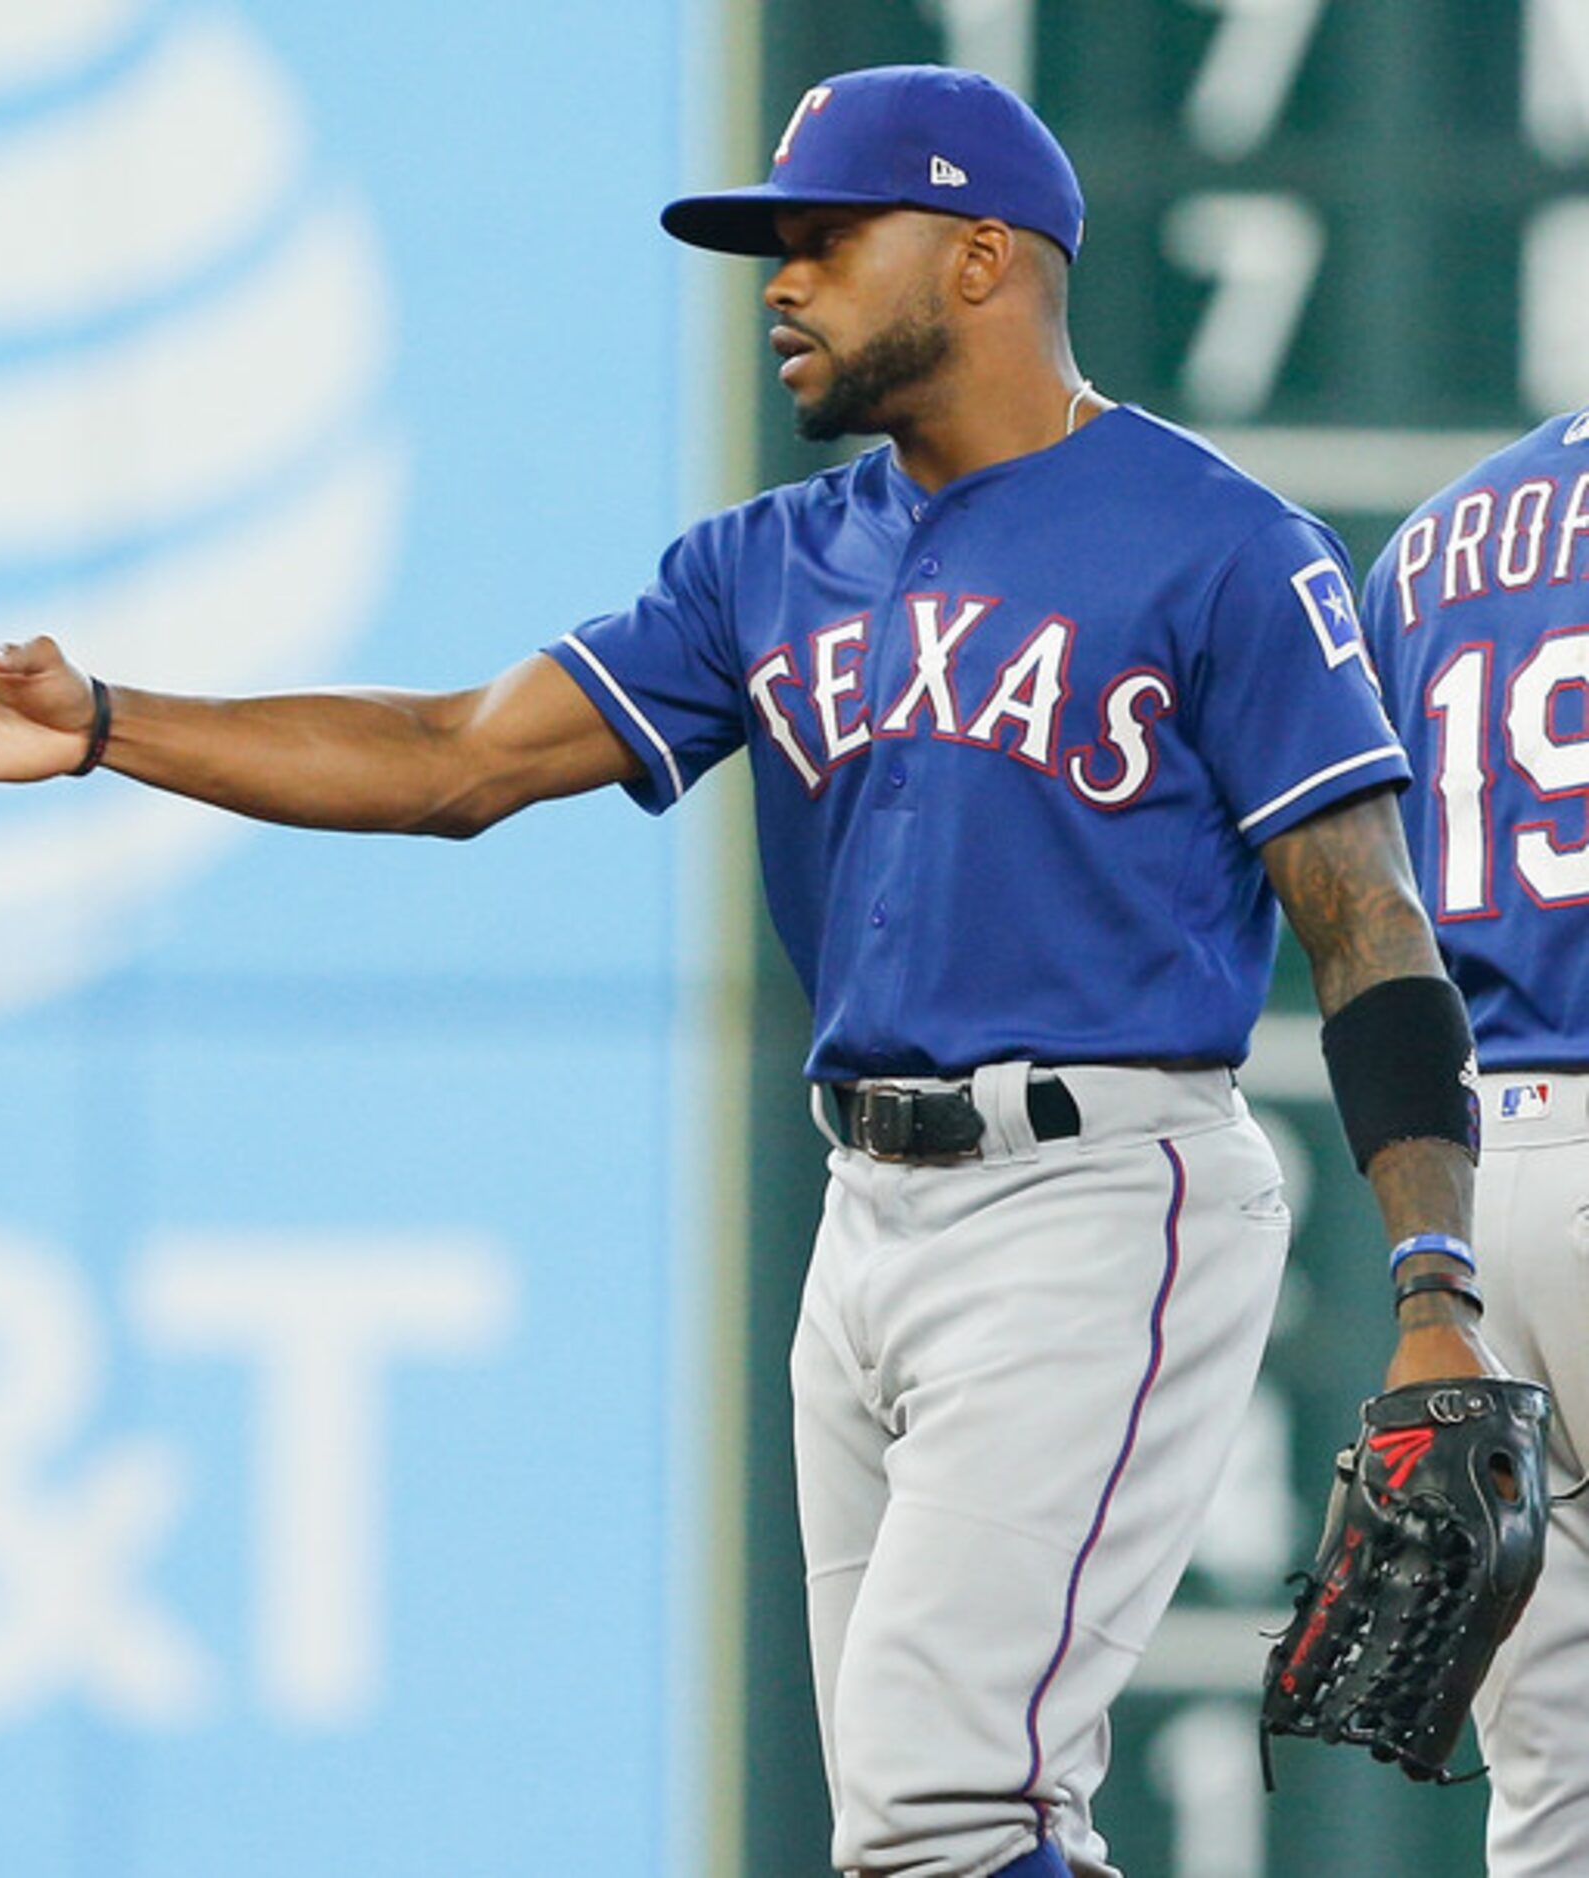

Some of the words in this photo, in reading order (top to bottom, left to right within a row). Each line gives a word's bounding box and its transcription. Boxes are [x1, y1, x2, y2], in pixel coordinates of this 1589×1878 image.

[1160, 192, 1325, 415] 7
[745, 592, 1177, 812] TEXAS
[1424, 623, 1589, 923] 19
